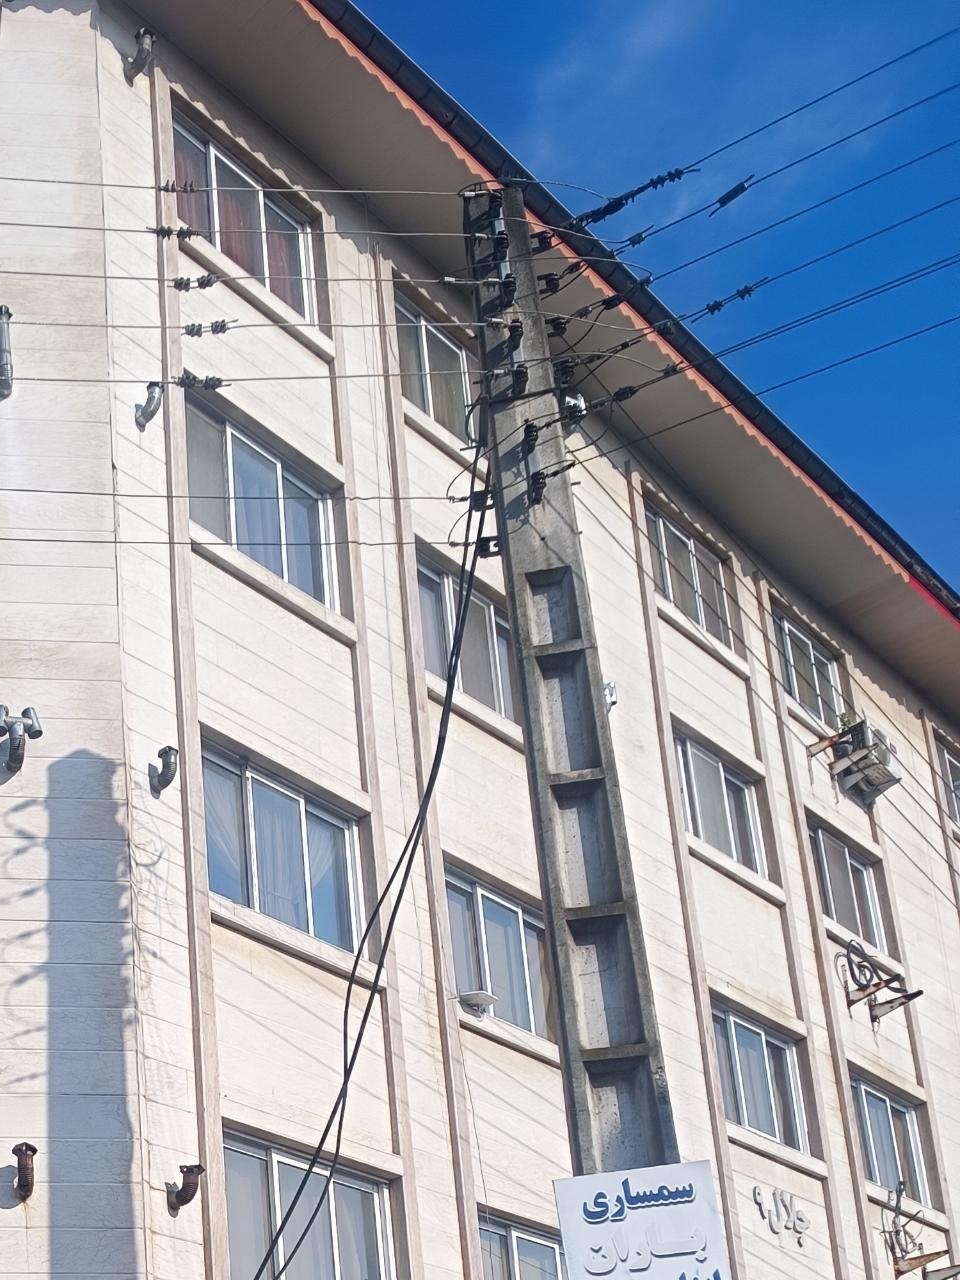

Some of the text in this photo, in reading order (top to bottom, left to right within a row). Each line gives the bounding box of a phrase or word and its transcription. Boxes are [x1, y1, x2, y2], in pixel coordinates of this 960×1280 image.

[582, 1177, 694, 1222] سمساری
[752, 1185, 767, 1220] ۹
[584, 1225, 707, 1276] باران
